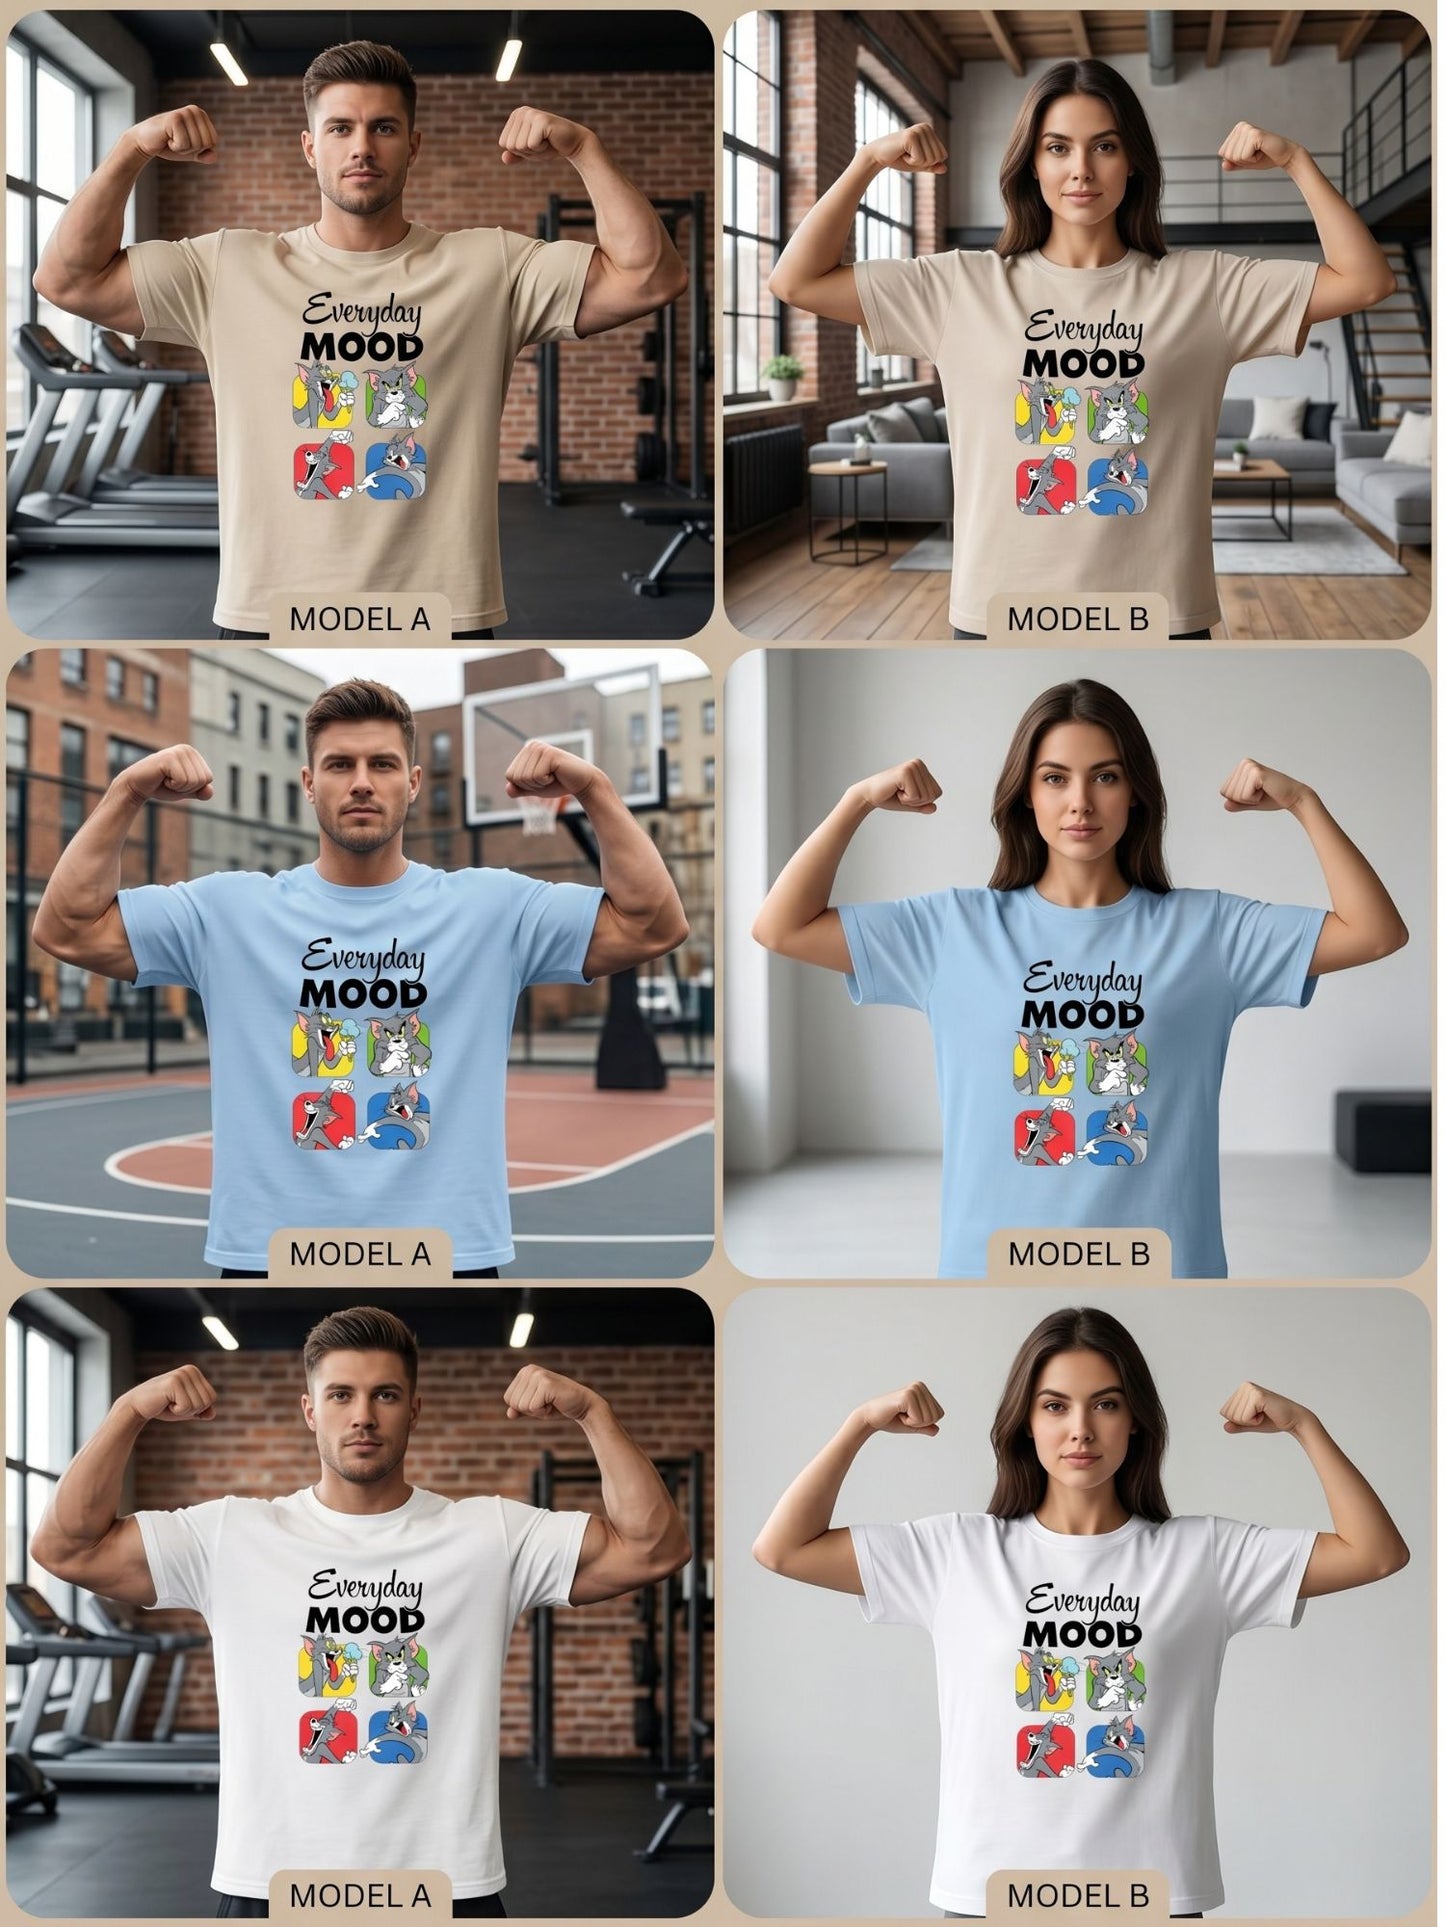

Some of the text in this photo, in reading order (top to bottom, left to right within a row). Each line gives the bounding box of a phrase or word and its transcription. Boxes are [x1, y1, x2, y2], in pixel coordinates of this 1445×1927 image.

[303, 292, 421, 336] Everyday
[1025, 309, 1143, 353] Everyday
[301, 332, 423, 361] MOOD
[1023, 348, 1145, 379] MOOD
[302, 938, 424, 983] Everyday
[300, 979, 427, 1009] MOOD
[1024, 960, 1142, 1005] Everyday
[1022, 1000, 1144, 1029] MOOD
[309, 1569, 422, 1610] Everyday
[1026, 1583, 1139, 1625] Everyday
[306, 1606, 425, 1634] MOOD
[1023, 1620, 1142, 1648] MOOD
